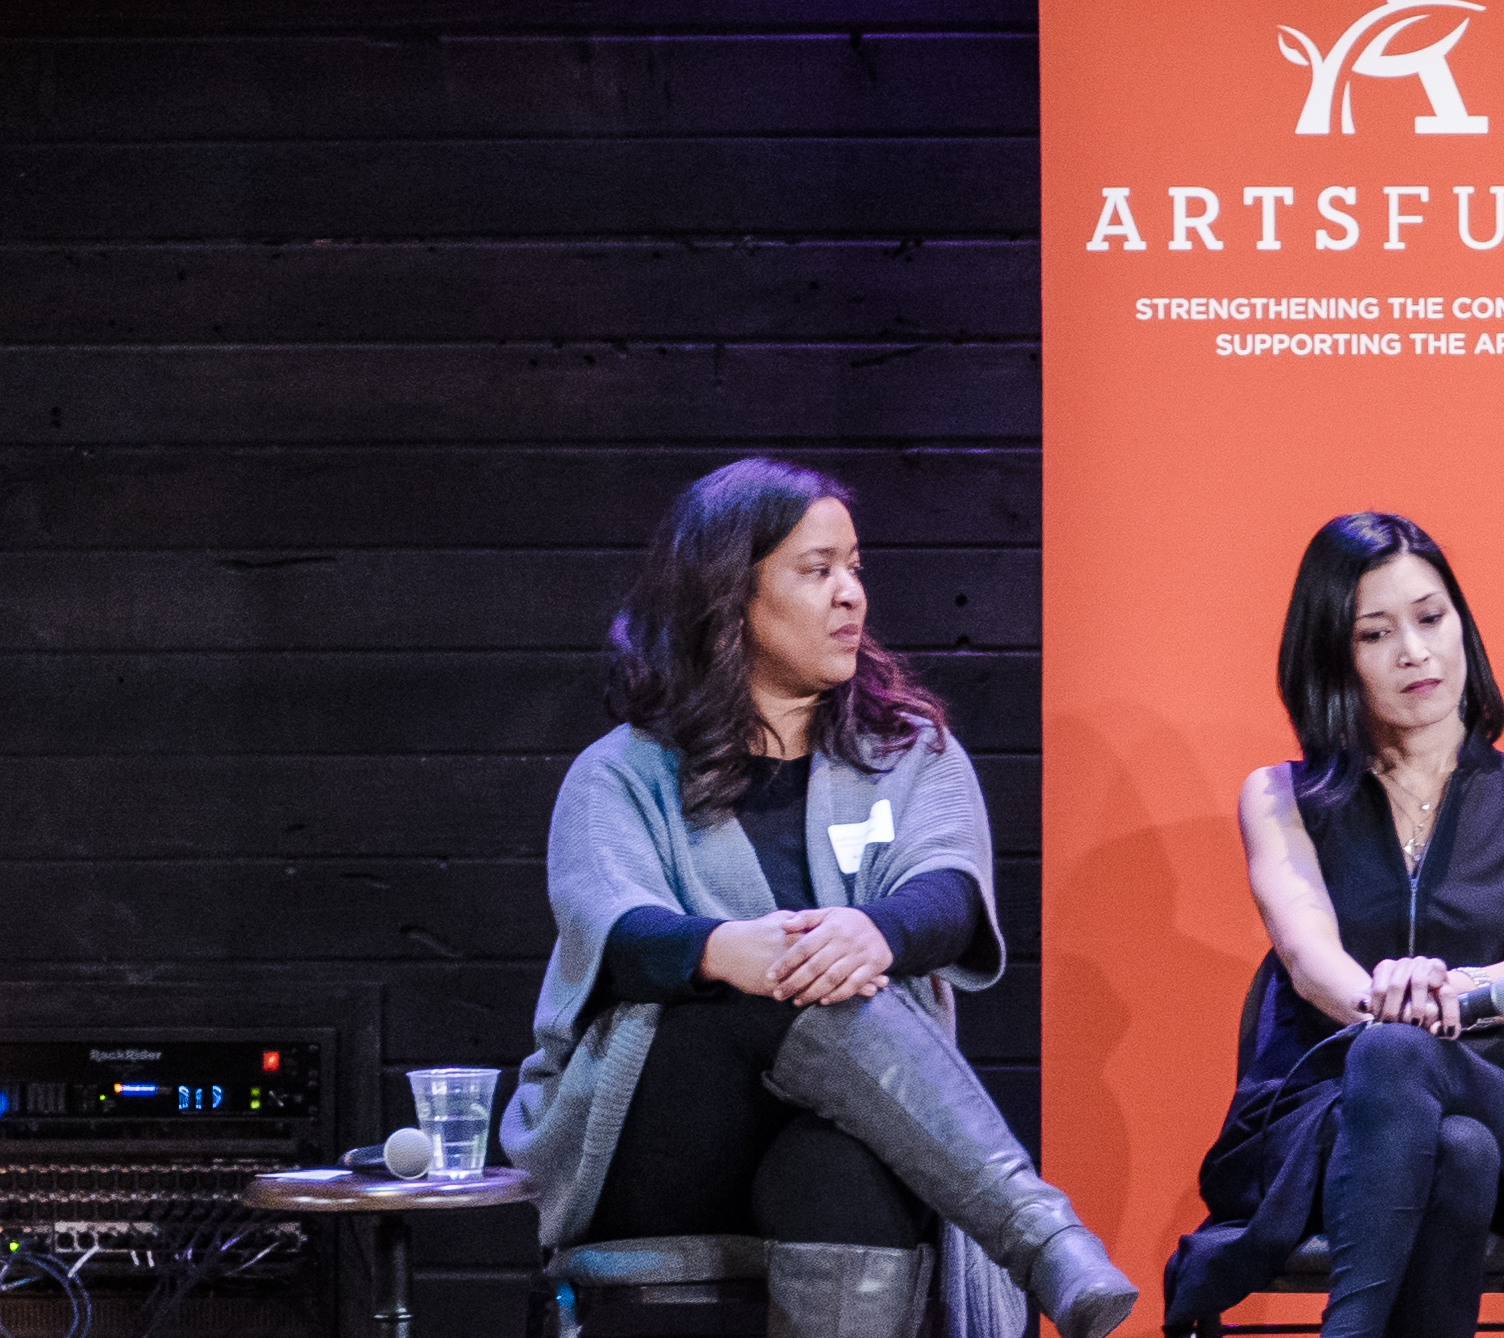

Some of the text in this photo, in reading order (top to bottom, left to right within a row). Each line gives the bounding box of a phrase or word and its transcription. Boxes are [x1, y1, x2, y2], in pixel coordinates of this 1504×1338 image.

[1135, 296, 1380, 321] STRENGTHENING
[1387, 296, 1445, 321] THE
[1215, 332, 1402, 357] SUPPORTING
[1409, 332, 1467, 357] THE
